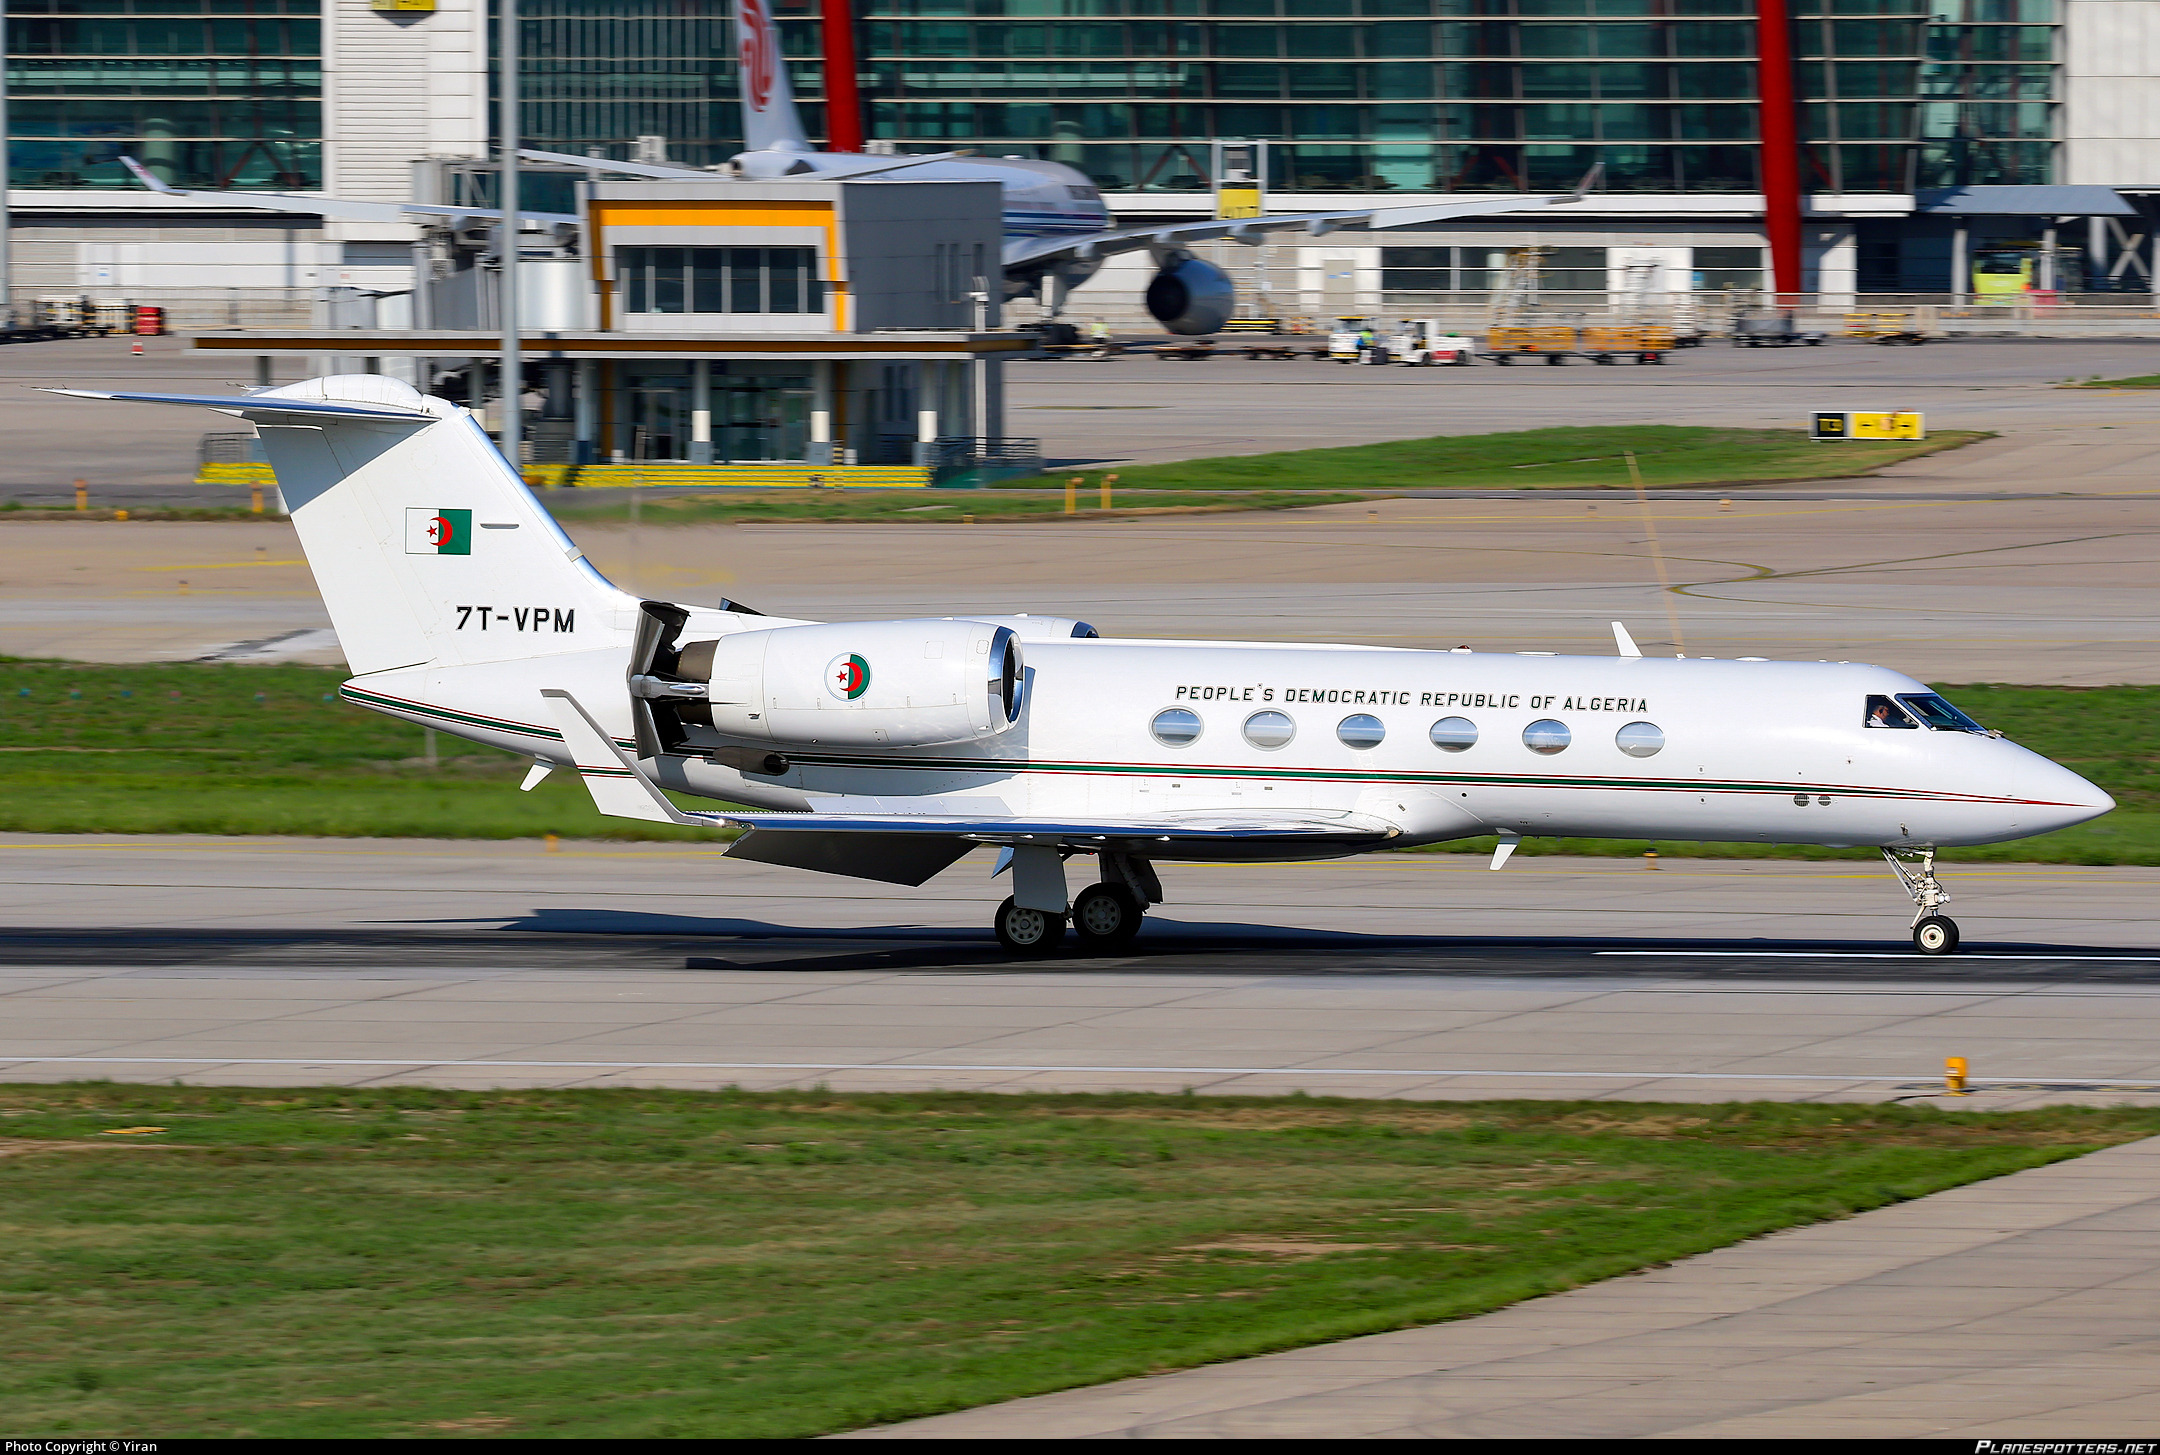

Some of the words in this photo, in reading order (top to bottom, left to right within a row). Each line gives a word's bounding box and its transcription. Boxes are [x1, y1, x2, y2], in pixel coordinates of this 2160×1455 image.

[455, 605, 575, 633] 7T-VPM
[1284, 687, 1412, 705] DEMOCRATIC
[1420, 692, 1520, 708] REPUBLIC
[1529, 695, 1556, 710] OF
[1562, 697, 1648, 713] ALGERIA
